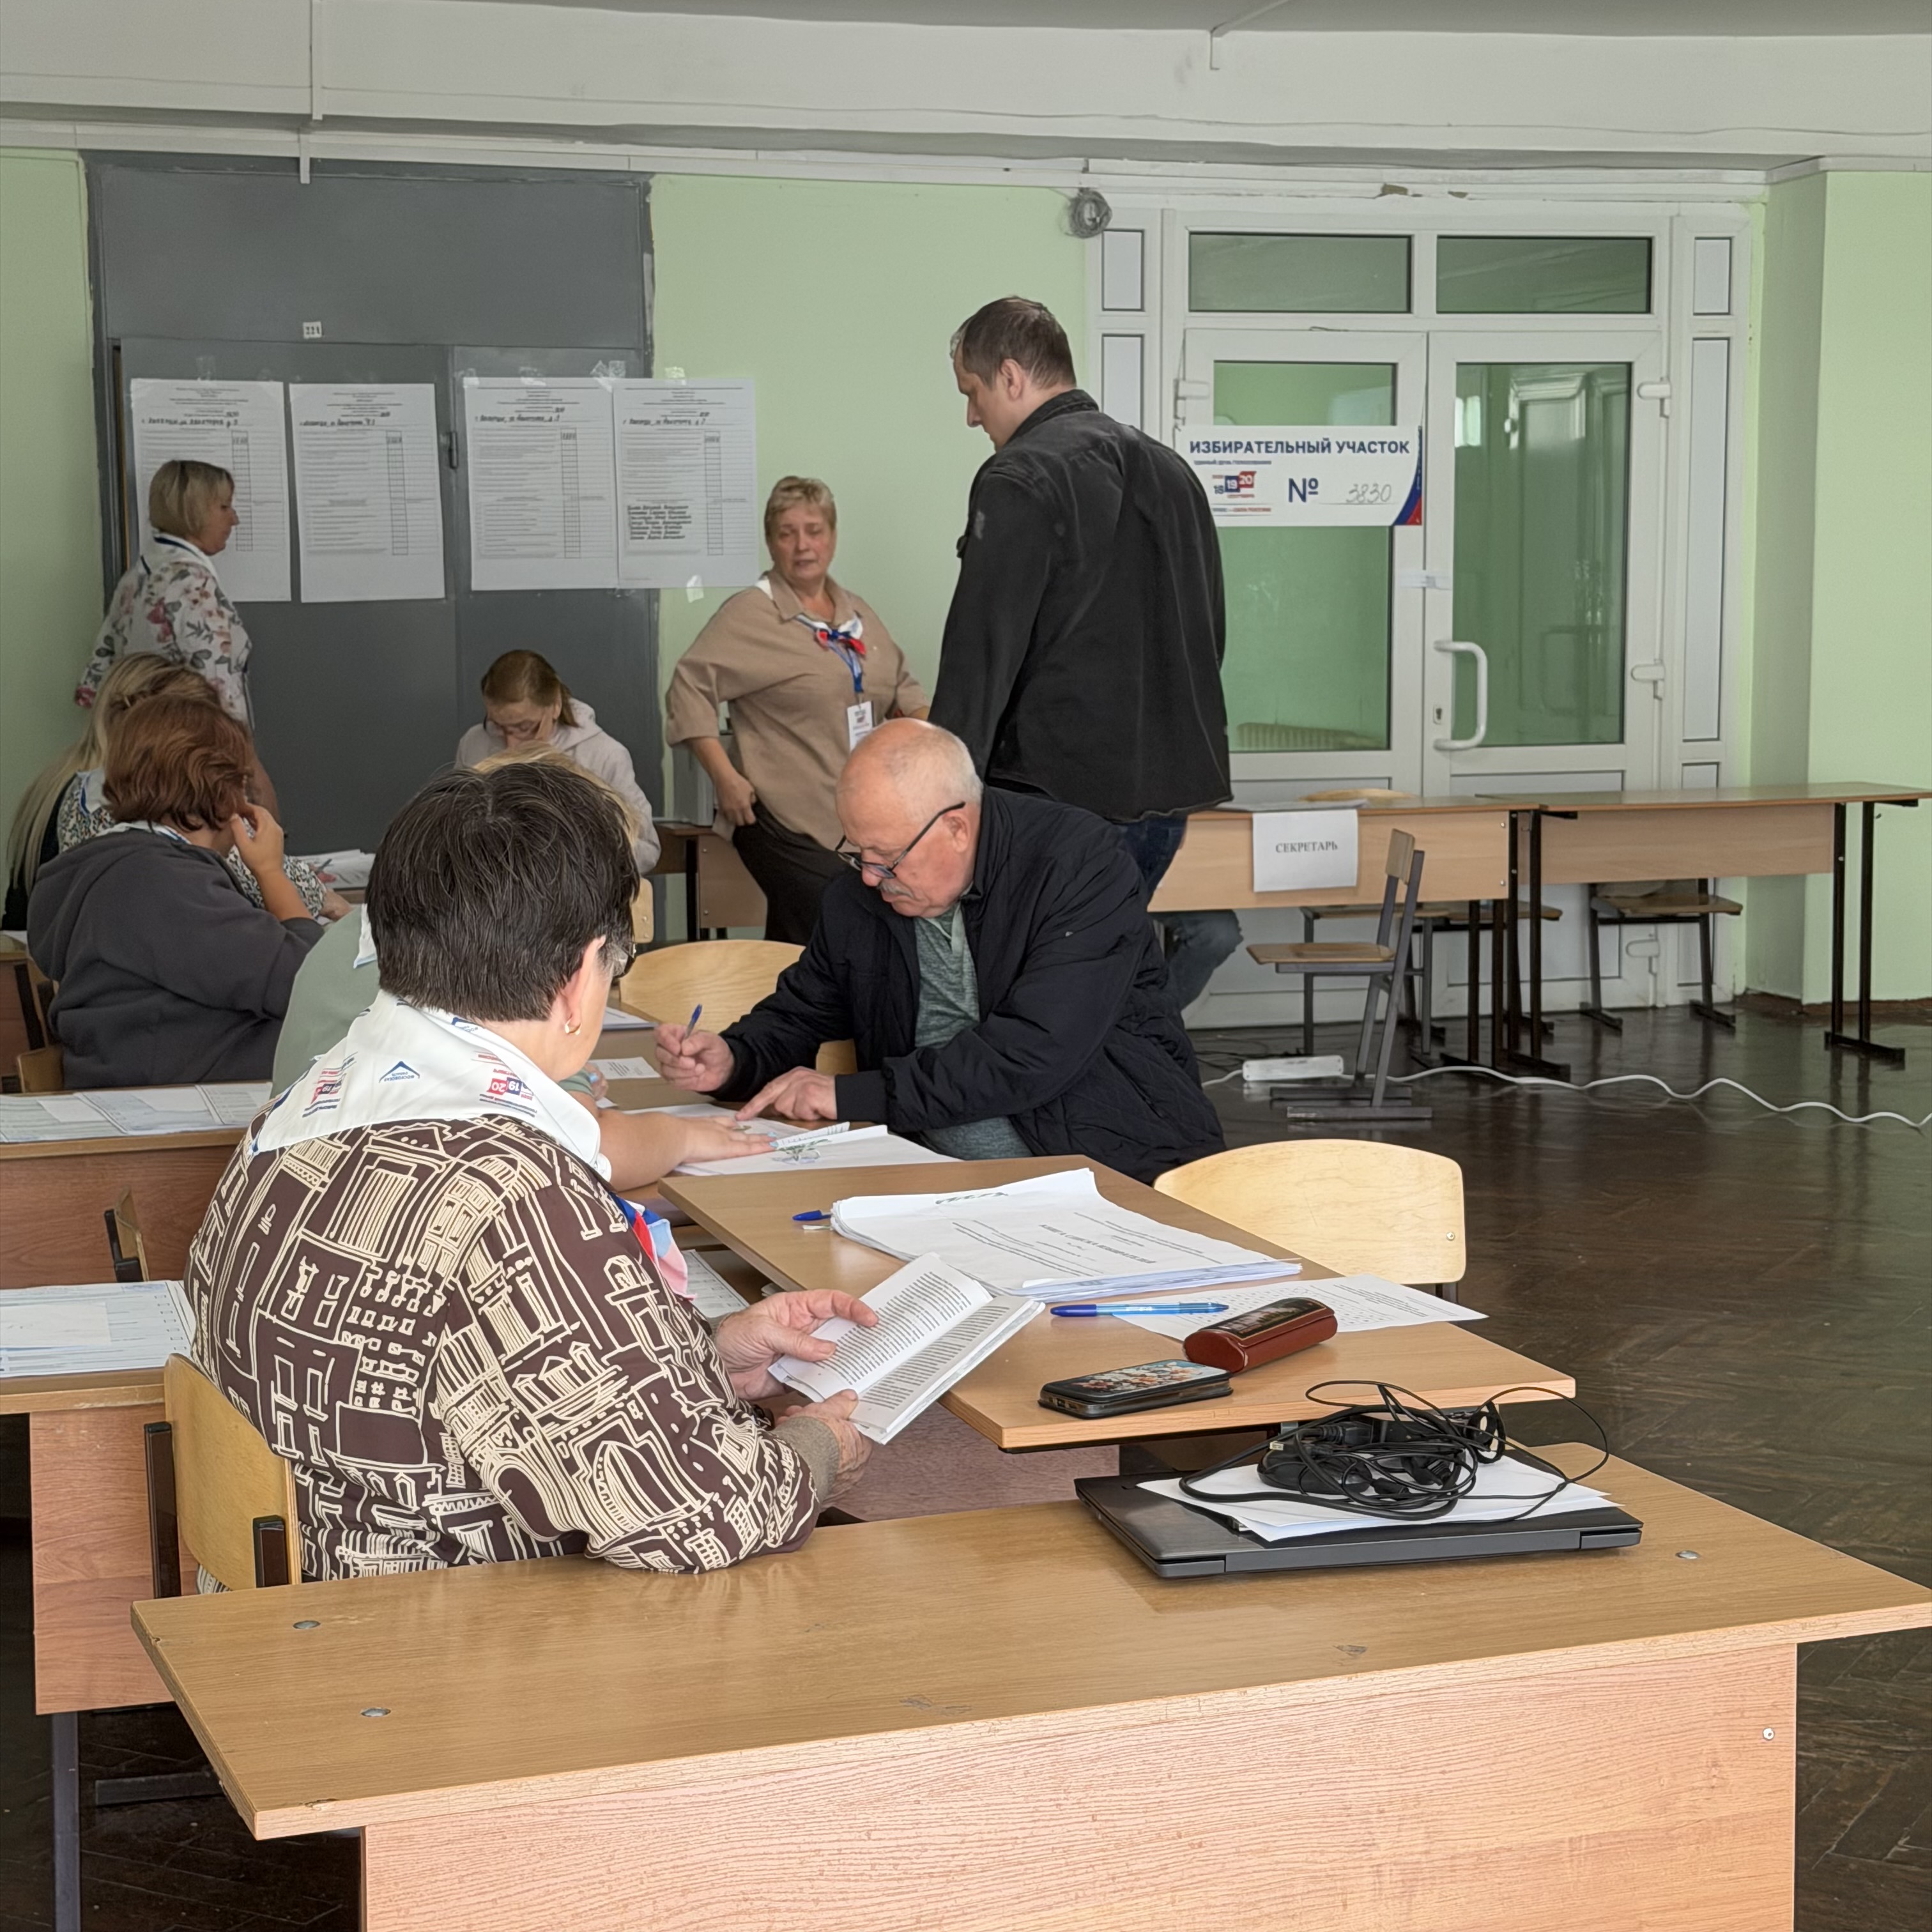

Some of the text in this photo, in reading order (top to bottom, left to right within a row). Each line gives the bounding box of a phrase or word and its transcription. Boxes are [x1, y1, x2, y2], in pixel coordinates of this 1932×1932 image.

[1190, 438, 1410, 454] ИЗБИРАТЕЛЬНЫЙ УЧАСТОК
[1239, 475, 1253, 485] 20
[1288, 478, 1319, 503] №
[1346, 482, 1392, 503] 3830
[1275, 841, 1338, 854] СЕКРЕТАРЬ
[491, 1080, 520, 1092] 19 20
